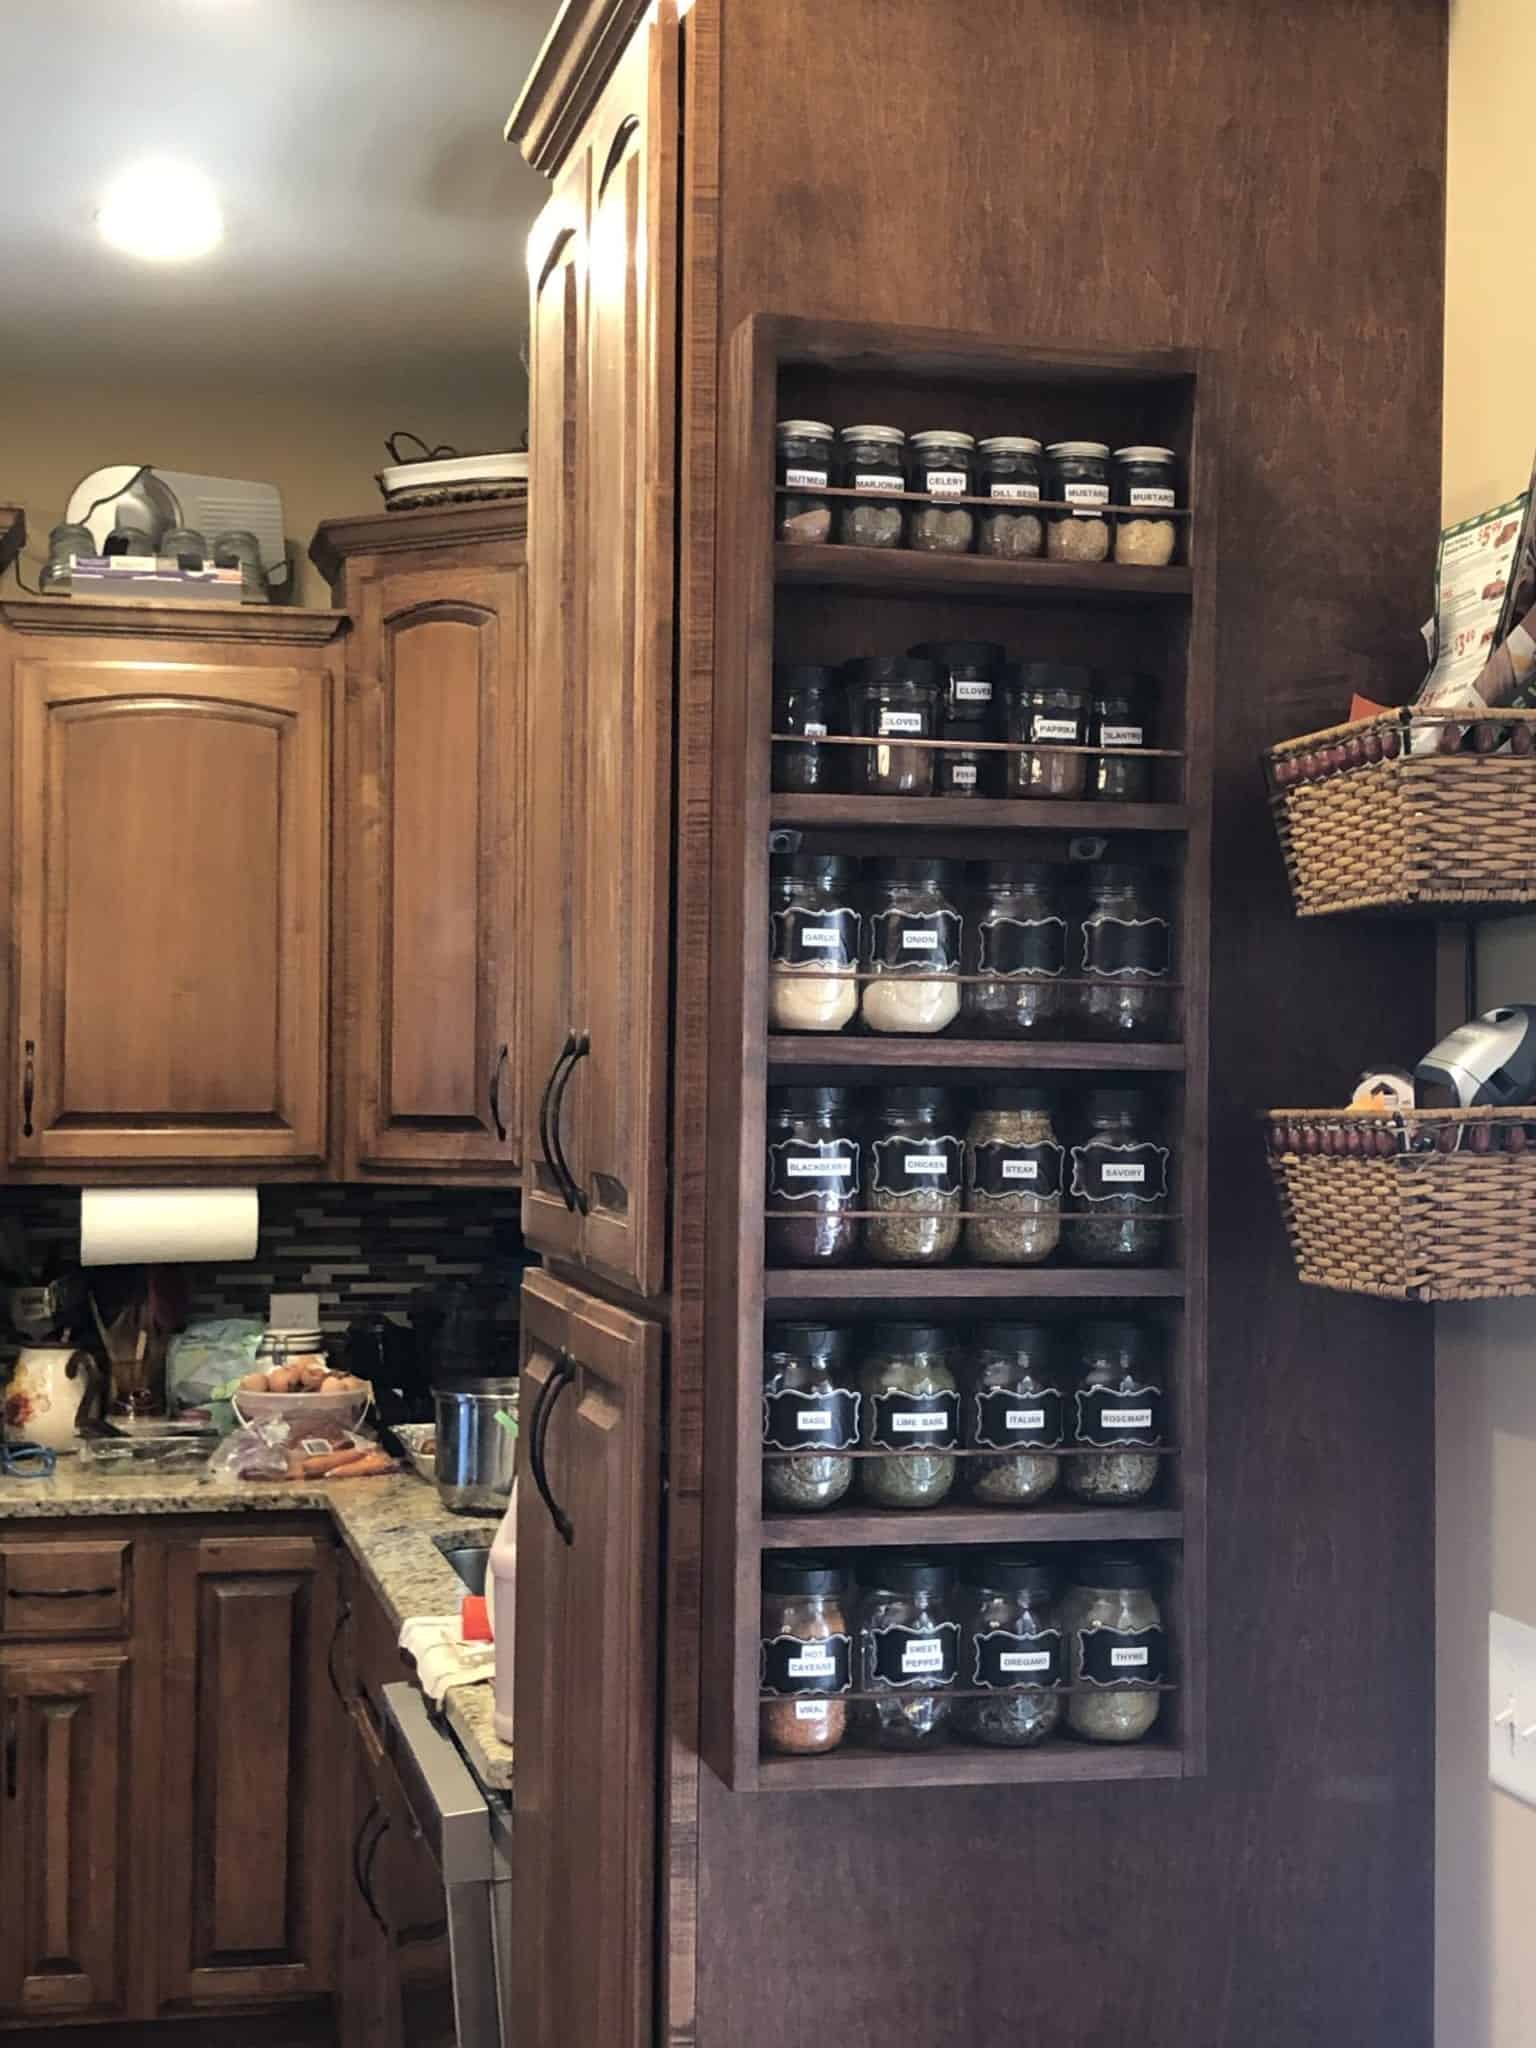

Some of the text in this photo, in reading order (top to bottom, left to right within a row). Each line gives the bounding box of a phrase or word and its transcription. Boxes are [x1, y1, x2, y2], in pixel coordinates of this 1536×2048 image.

[787, 476, 826, 486] NUTMEG
[928, 477, 963, 487] CELERY
[884, 718, 920, 727] CLOVES
[905, 935, 936, 944] ONION
[907, 1160, 945, 1169] CHICKEN
[1005, 1165, 1033, 1174] STEAK
[1105, 1168, 1142, 1177] SAVORY
[896, 1417, 917, 1427] LIME
[1009, 1415, 1042, 1424] ITALIAN
[1103, 1414, 1150, 1424] ROSEMARY
[909, 1644, 938, 1654] SWEET
[904, 1657, 941, 1667] PEPPER
[1003, 1656, 1047, 1667] OREGANO
[1115, 1652, 1144, 1662] THYME
